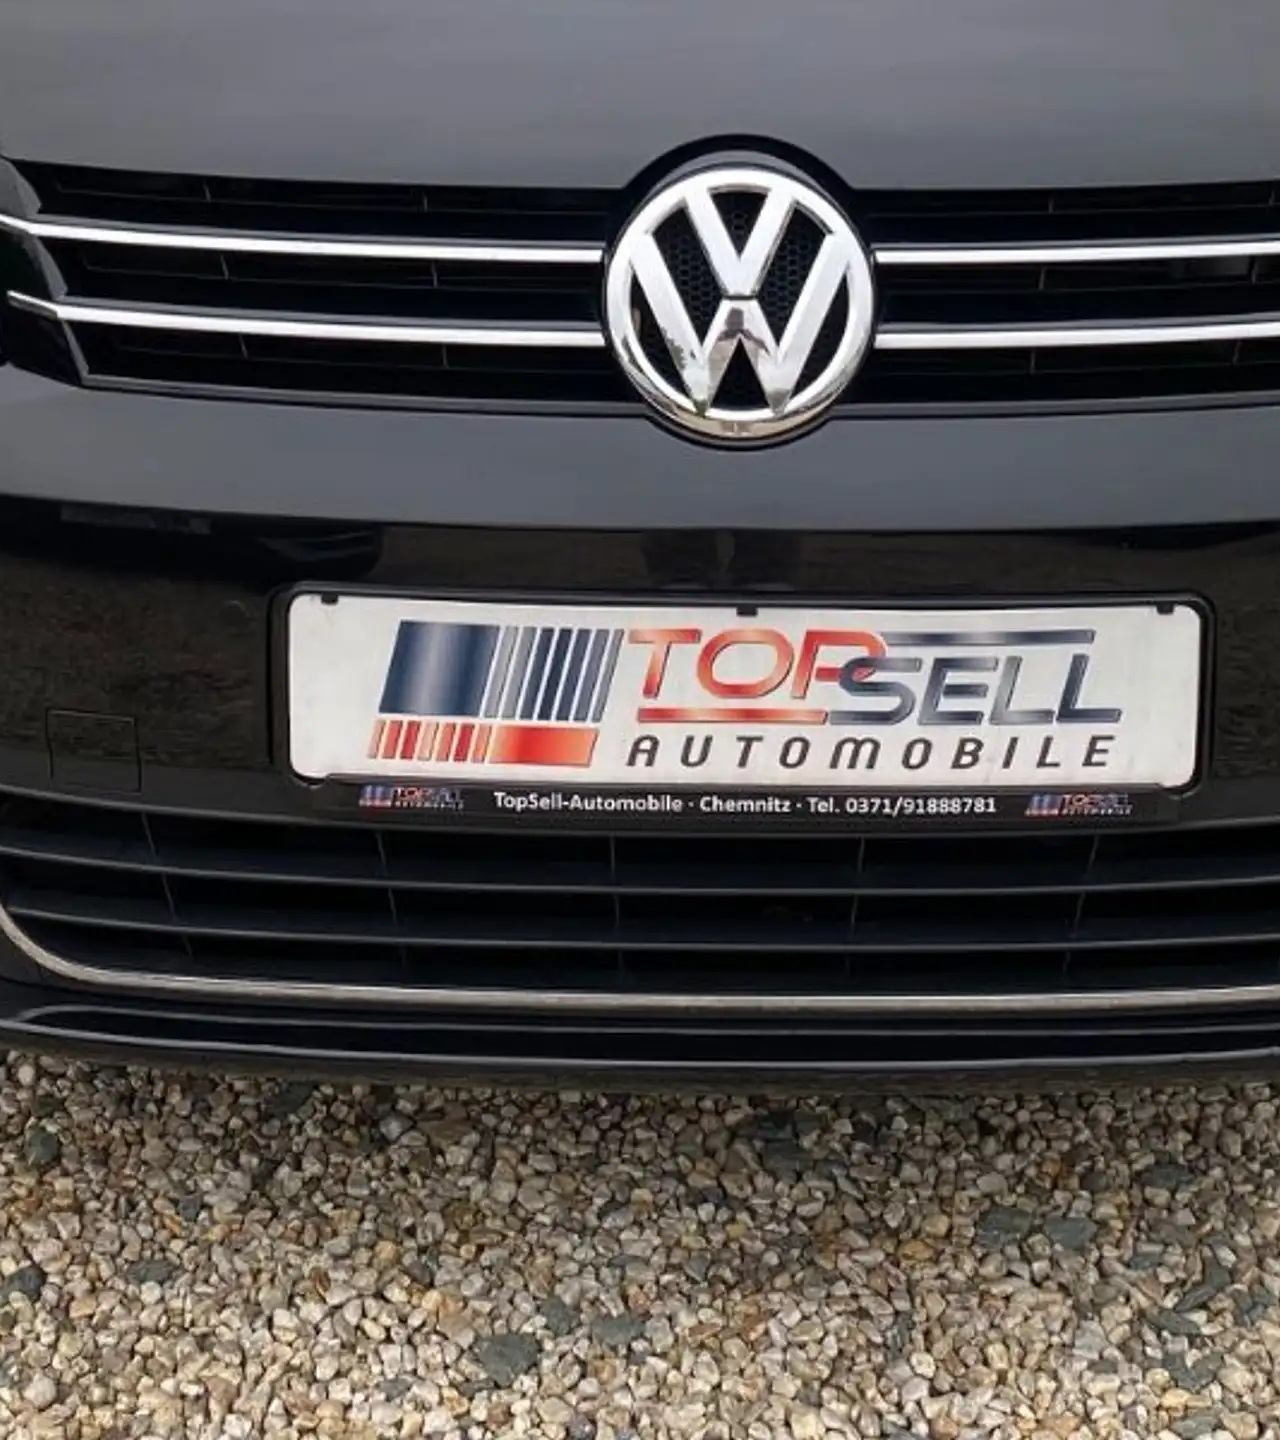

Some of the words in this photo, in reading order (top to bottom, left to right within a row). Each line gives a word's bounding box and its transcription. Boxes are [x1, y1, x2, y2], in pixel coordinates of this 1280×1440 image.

[616, 174, 862, 426] VW
[625, 734, 1116, 770] AUTOMOBILE
[494, 791, 682, 812] TopSell-Automobile
[700, 796, 791, 813] Chemnitz
[807, 797, 840, 814] Tel.
[846, 796, 996, 817] 0371/91888781
